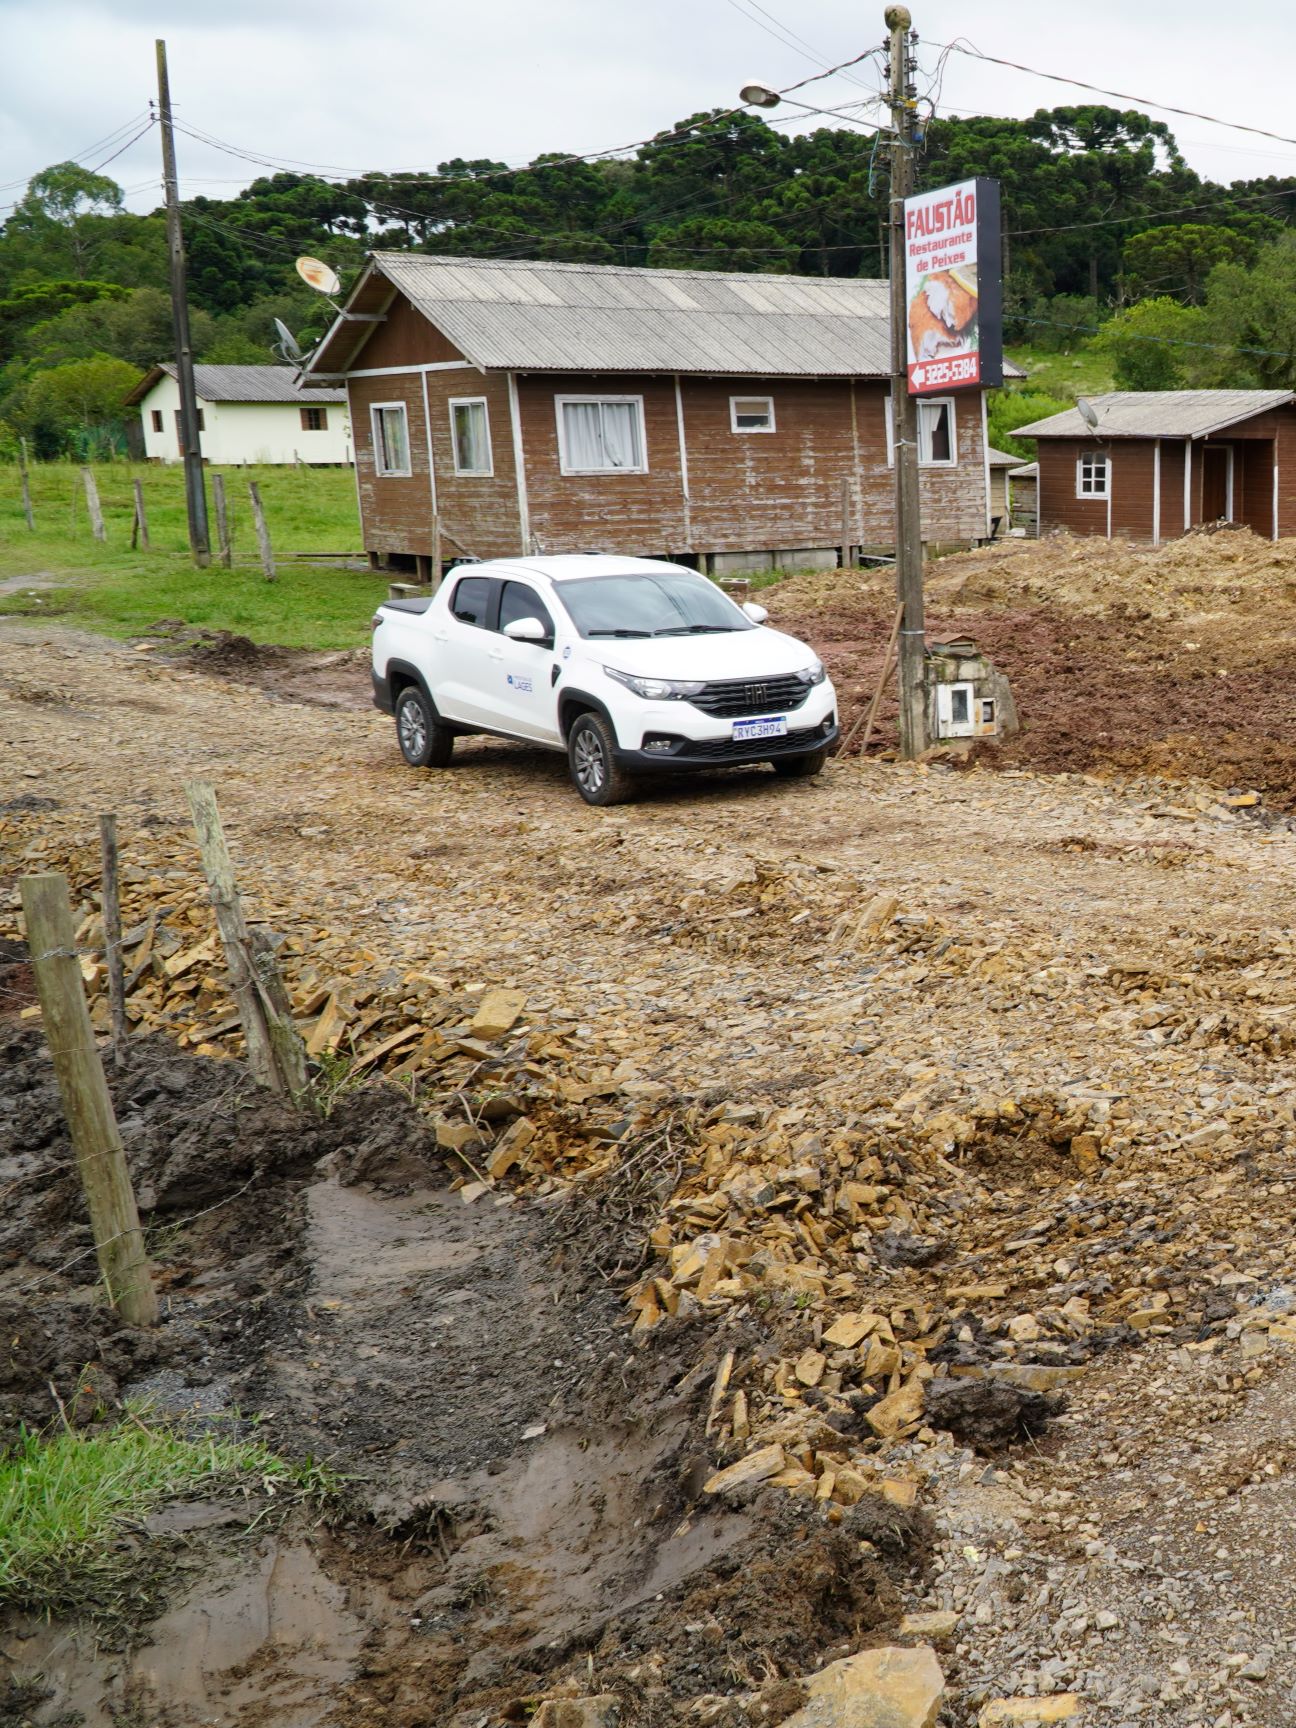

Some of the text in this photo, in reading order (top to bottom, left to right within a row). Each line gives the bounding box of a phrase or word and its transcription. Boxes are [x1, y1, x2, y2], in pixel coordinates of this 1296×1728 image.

[906, 190, 975, 240] FAUSTÃO
[909, 232, 973, 256] Restaurante
[916, 251, 966, 272] de Peixes
[925, 357, 977, 385] 3225-5384
[744, 683, 769, 705] FIAT
[737, 723, 781, 738] RYC3H94
